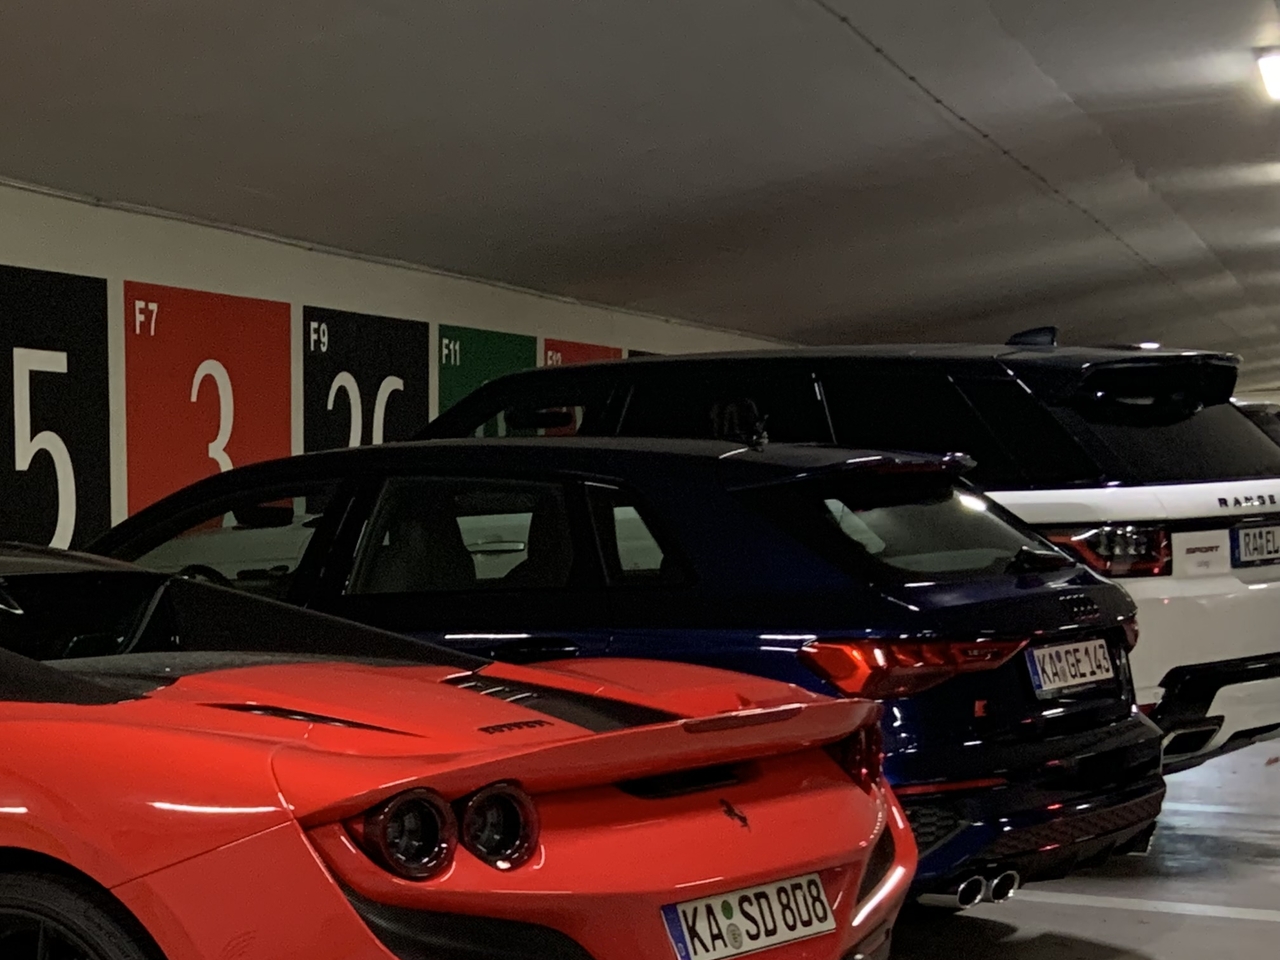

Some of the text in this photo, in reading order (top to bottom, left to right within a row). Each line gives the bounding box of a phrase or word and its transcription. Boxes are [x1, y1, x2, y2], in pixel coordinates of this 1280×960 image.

[134, 299, 158, 336] F7
[310, 321, 329, 352] F9
[442, 338, 460, 366] F11
[1037, 643, 1110, 685] KA GE 143
[681, 878, 828, 956] KA SD 808
